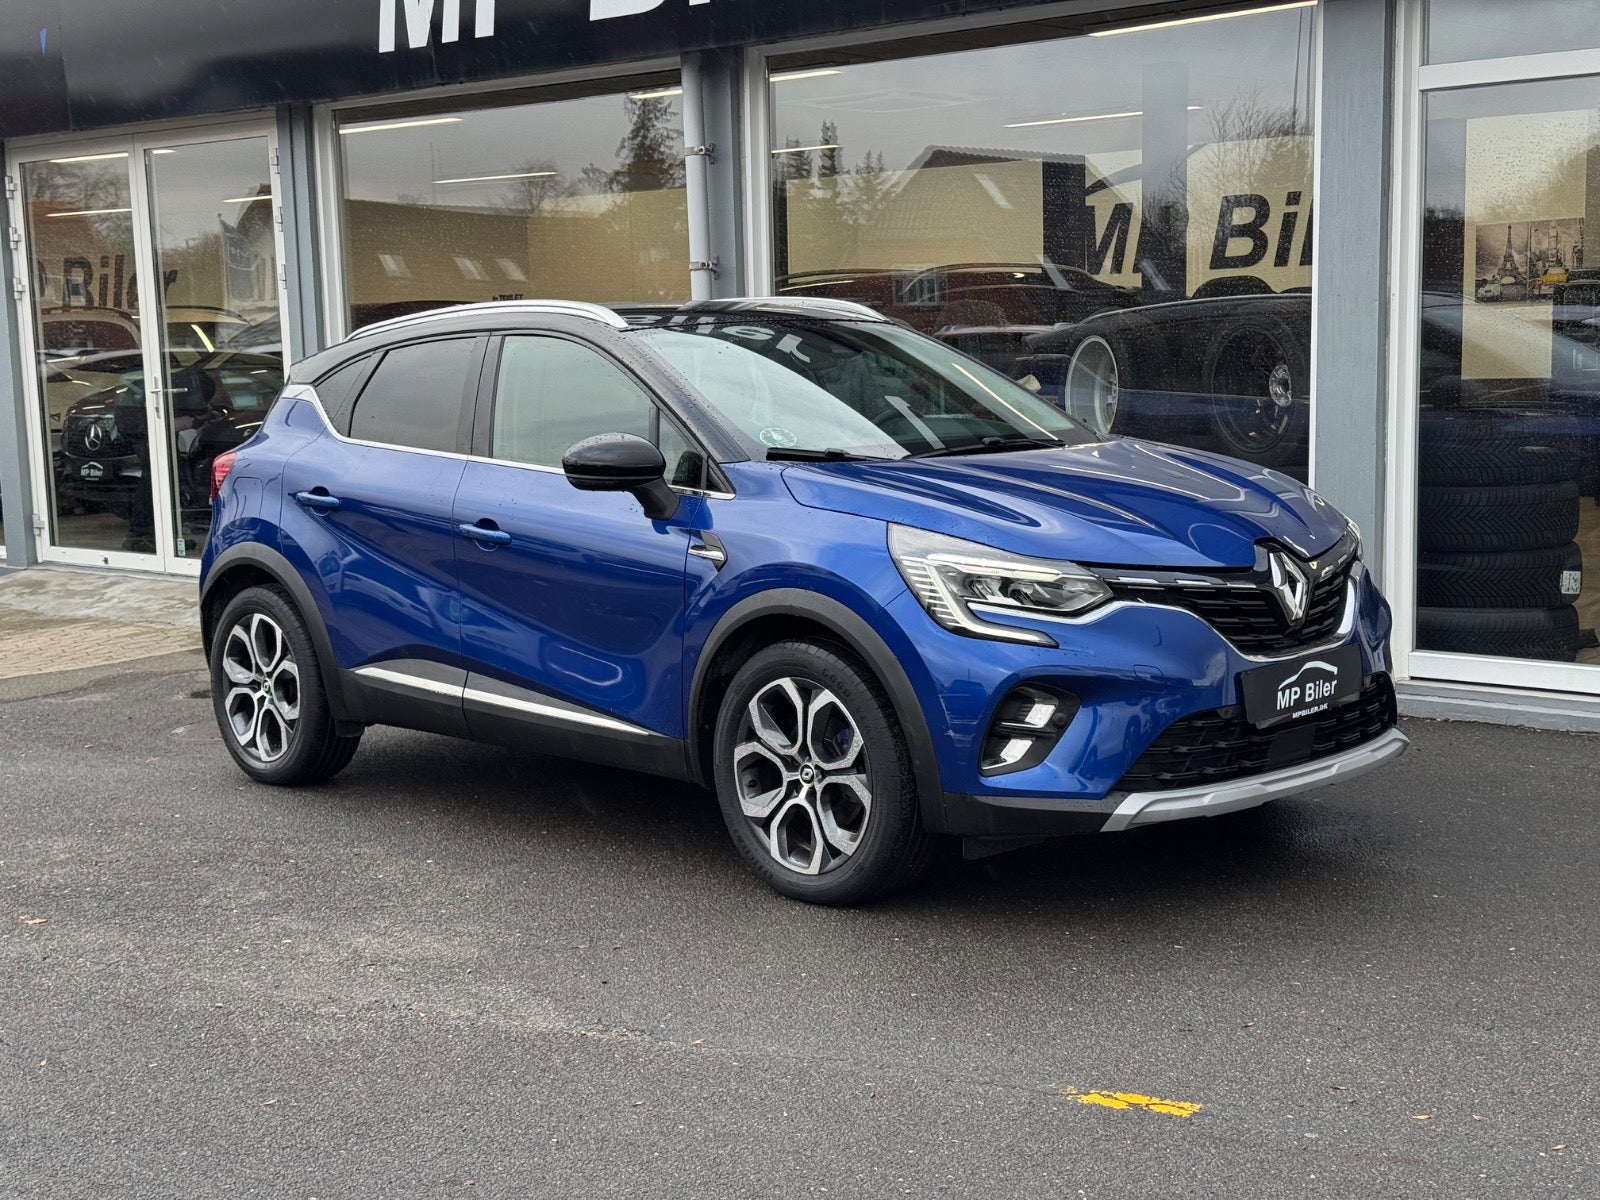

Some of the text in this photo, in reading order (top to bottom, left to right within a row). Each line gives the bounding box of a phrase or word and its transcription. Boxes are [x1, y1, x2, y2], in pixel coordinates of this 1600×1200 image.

[1276, 679, 1338, 711] MP Biler
[1292, 702, 1329, 719] MPBILER.DK
